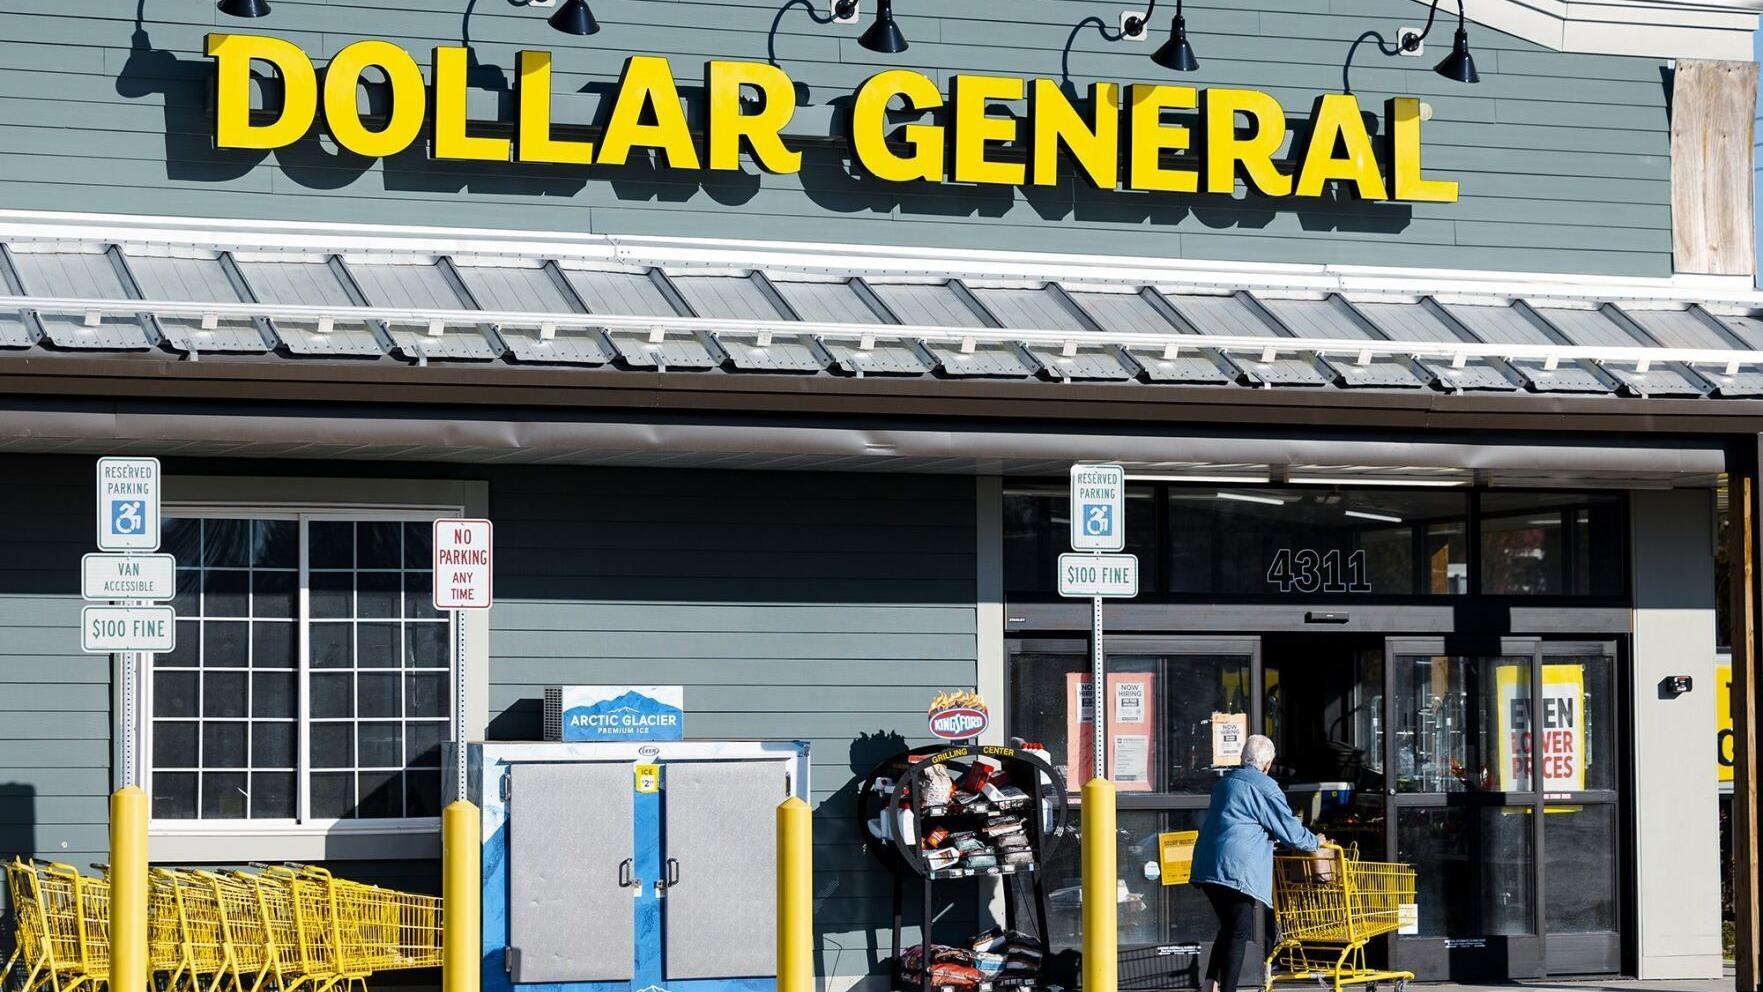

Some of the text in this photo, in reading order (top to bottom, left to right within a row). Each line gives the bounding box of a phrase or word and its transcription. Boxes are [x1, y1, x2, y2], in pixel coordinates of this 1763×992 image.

[204, 33, 1460, 203] DOLLAR GENERAL
[105, 466, 152, 479] RESERVED
[1077, 472, 1118, 485] RESERVED
[108, 482, 150, 495] PARKING
[1080, 488, 1116, 499] PARKING
[455, 529, 472, 544] NO
[440, 549, 487, 565] PARKING
[118, 562, 140, 577] VAN
[1067, 565, 1130, 585] $100 FINE
[1266, 548, 1372, 593] 4311
[452, 572, 473, 583] ANY
[104, 580, 155, 592] ACCESSIBLE
[451, 588, 474, 600] TIME
[92, 618, 166, 640] $100 FINE
[570, 714, 677, 726] ARCTIC GLACIER
[934, 714, 982, 733] KINGSFORD
[931, 746, 1015, 764] GRILLING CENTER
[641, 768, 654, 776] ICE
[1511, 755, 1574, 780] PRCES
